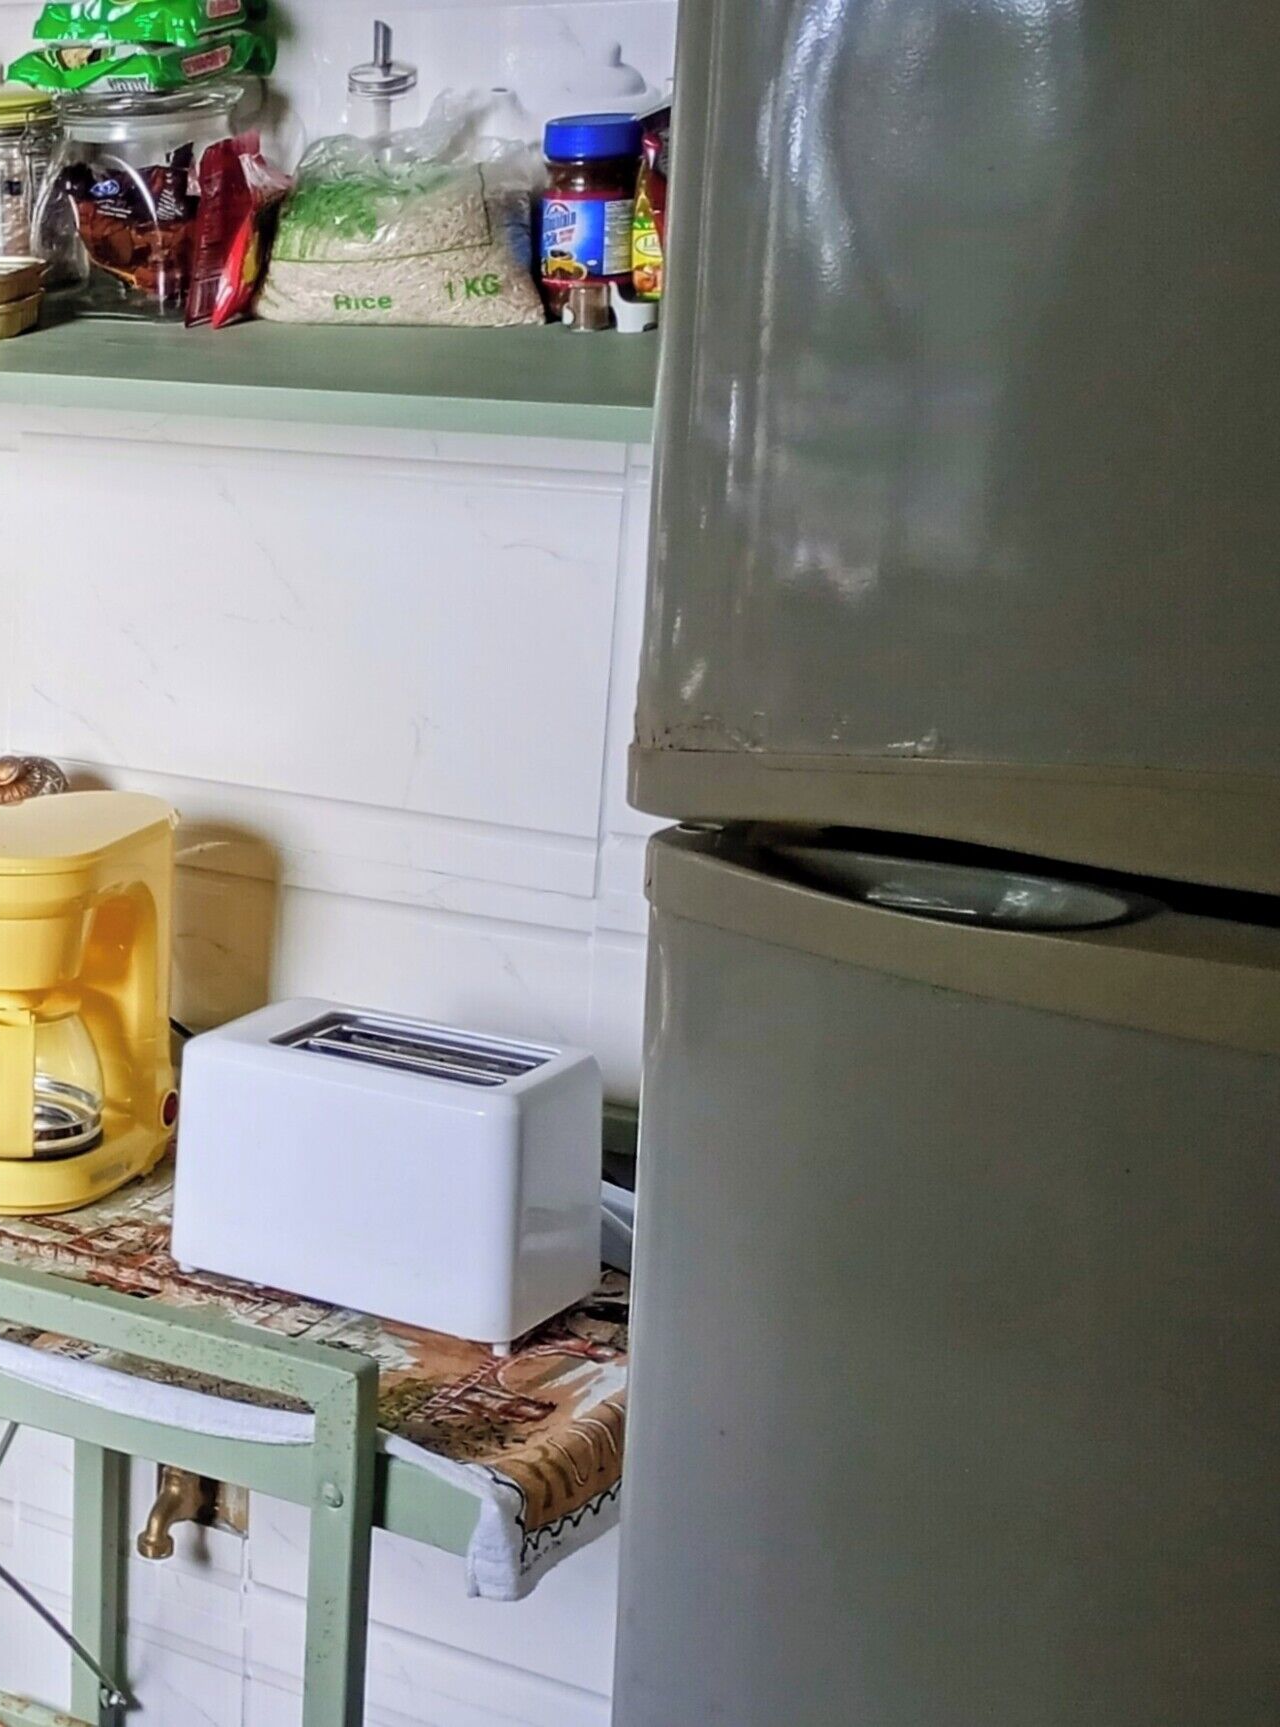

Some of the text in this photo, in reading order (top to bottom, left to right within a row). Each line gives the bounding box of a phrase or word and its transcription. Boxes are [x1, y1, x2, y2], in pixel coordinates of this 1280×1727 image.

[444, 273, 502, 301] 1 KG
[333, 294, 393, 310] Rice
